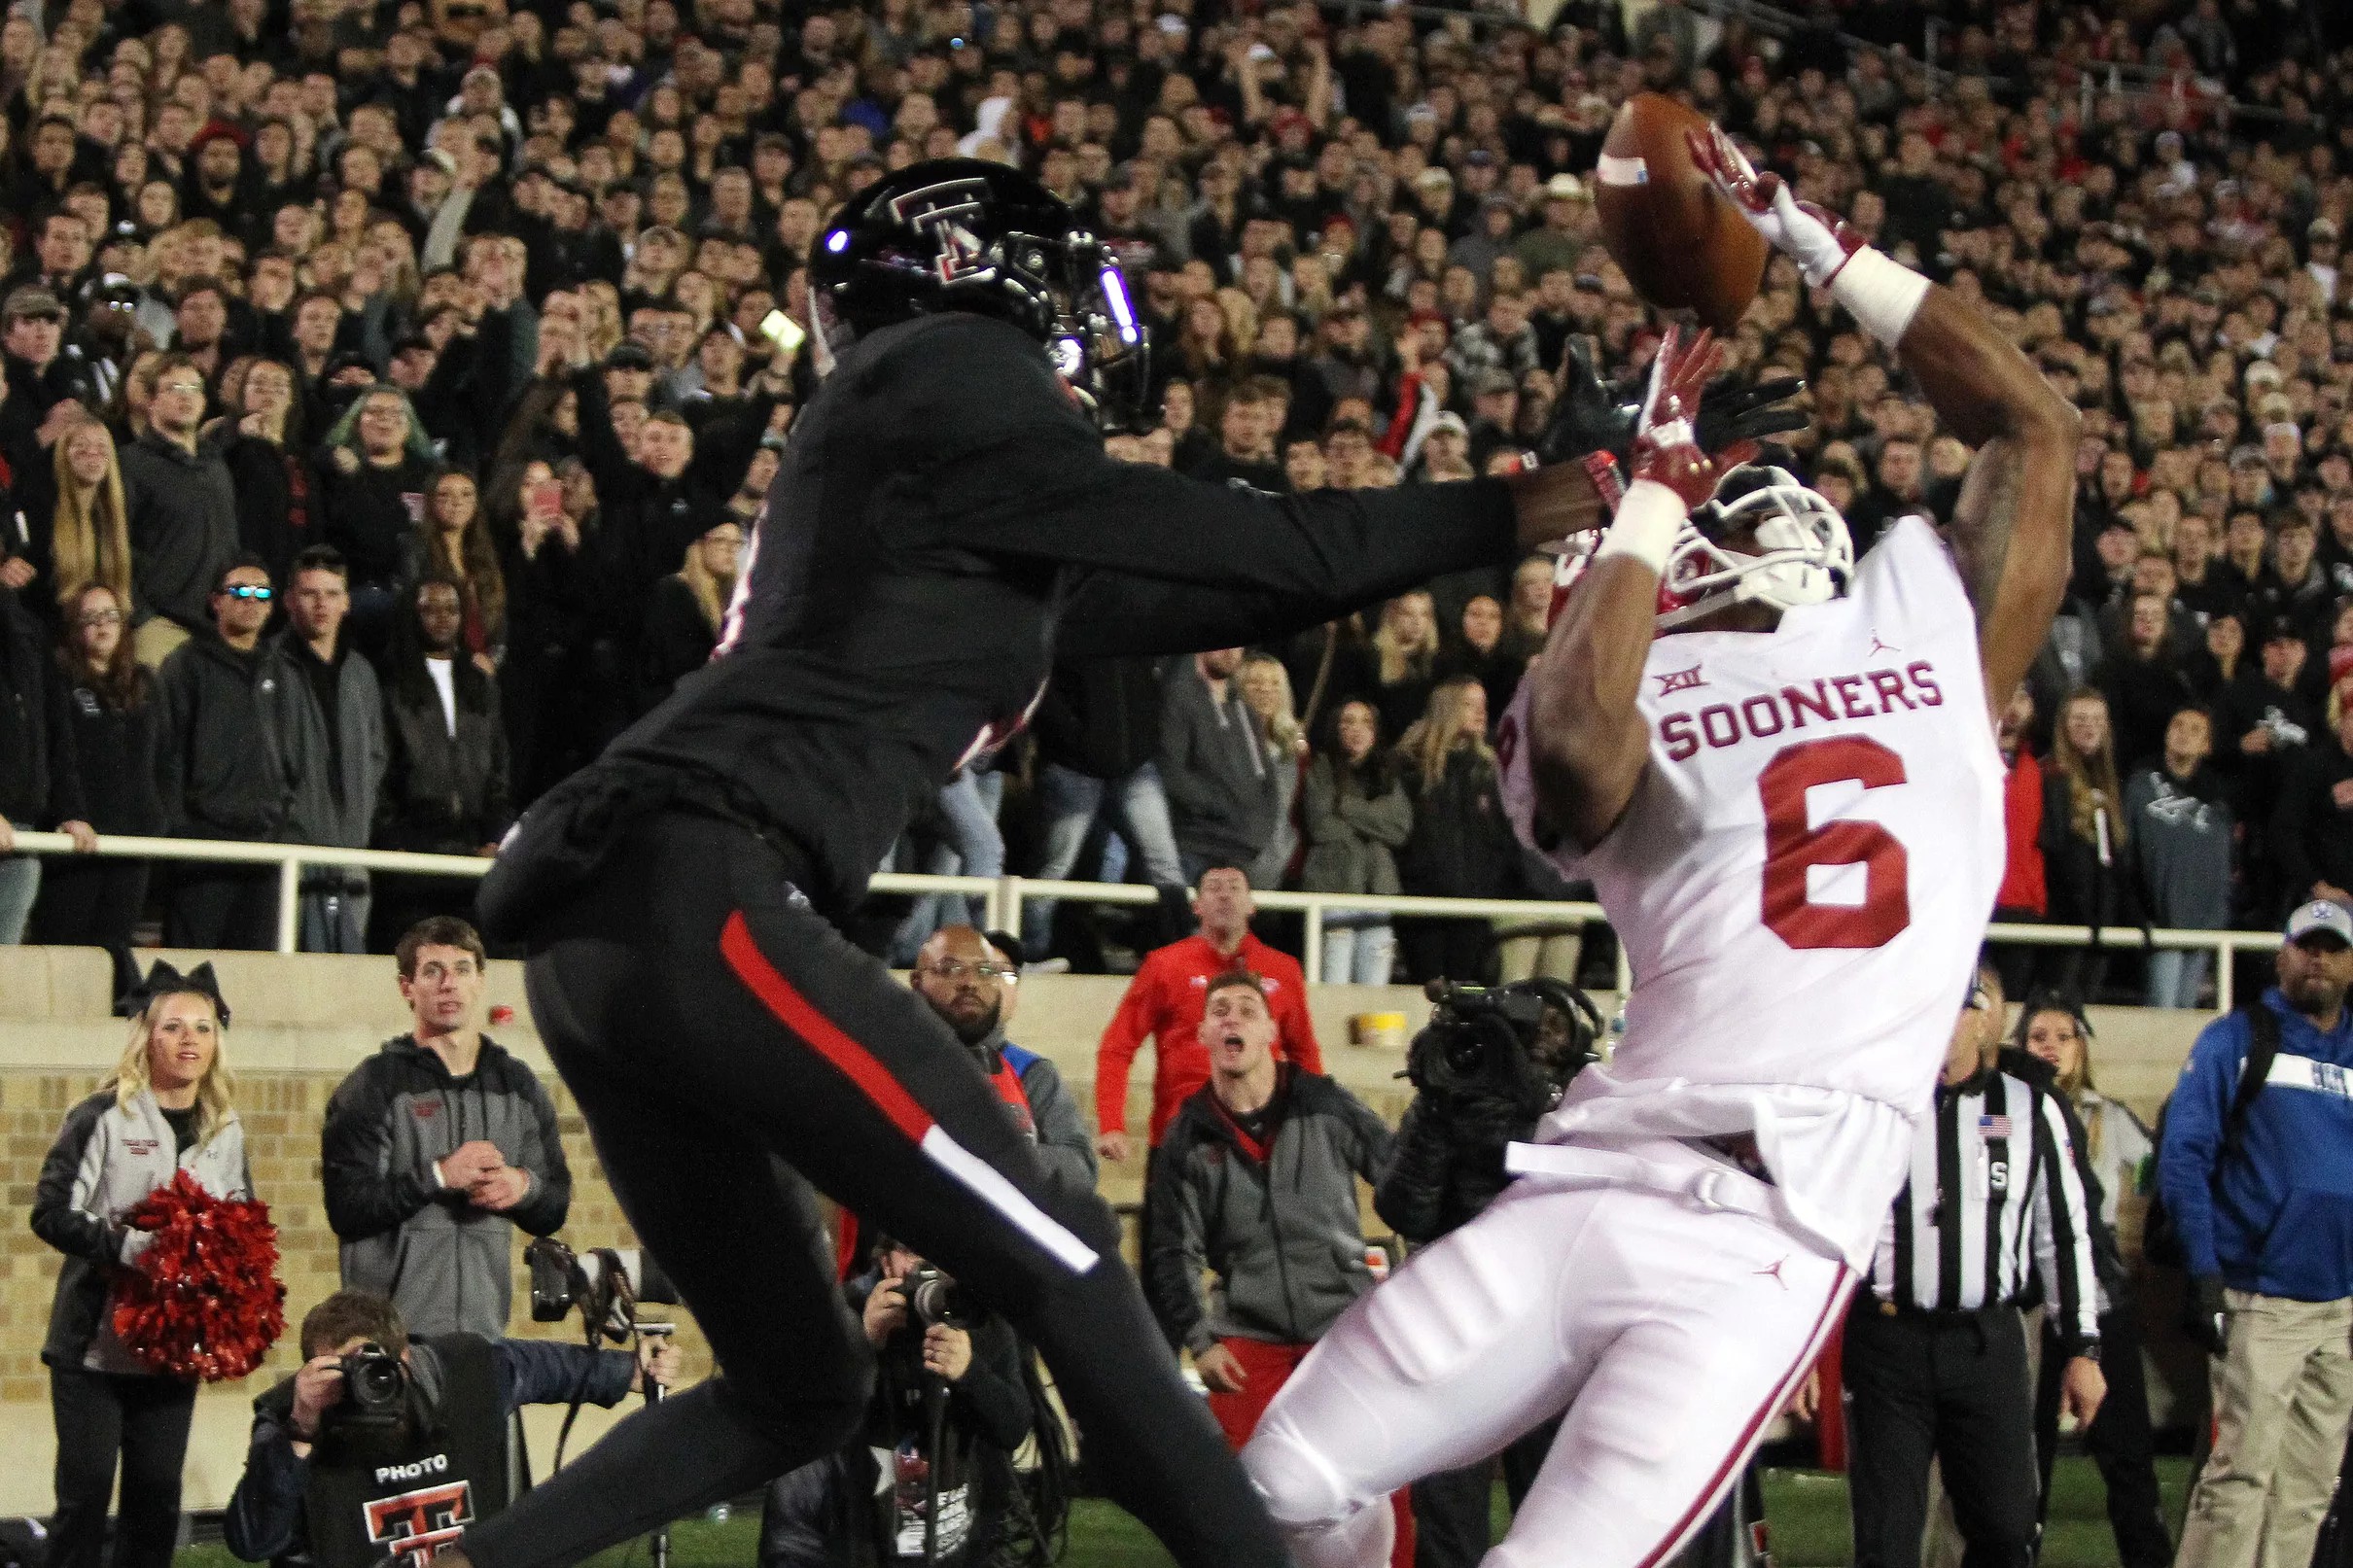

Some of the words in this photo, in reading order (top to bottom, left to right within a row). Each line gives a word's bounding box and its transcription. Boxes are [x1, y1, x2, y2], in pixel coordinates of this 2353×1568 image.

[1659, 659, 1943, 761] SOONERS
[1756, 732, 1912, 950] 6
[1990, 1161, 2008, 1188] S
[374, 1453, 448, 1484] PHOTO
